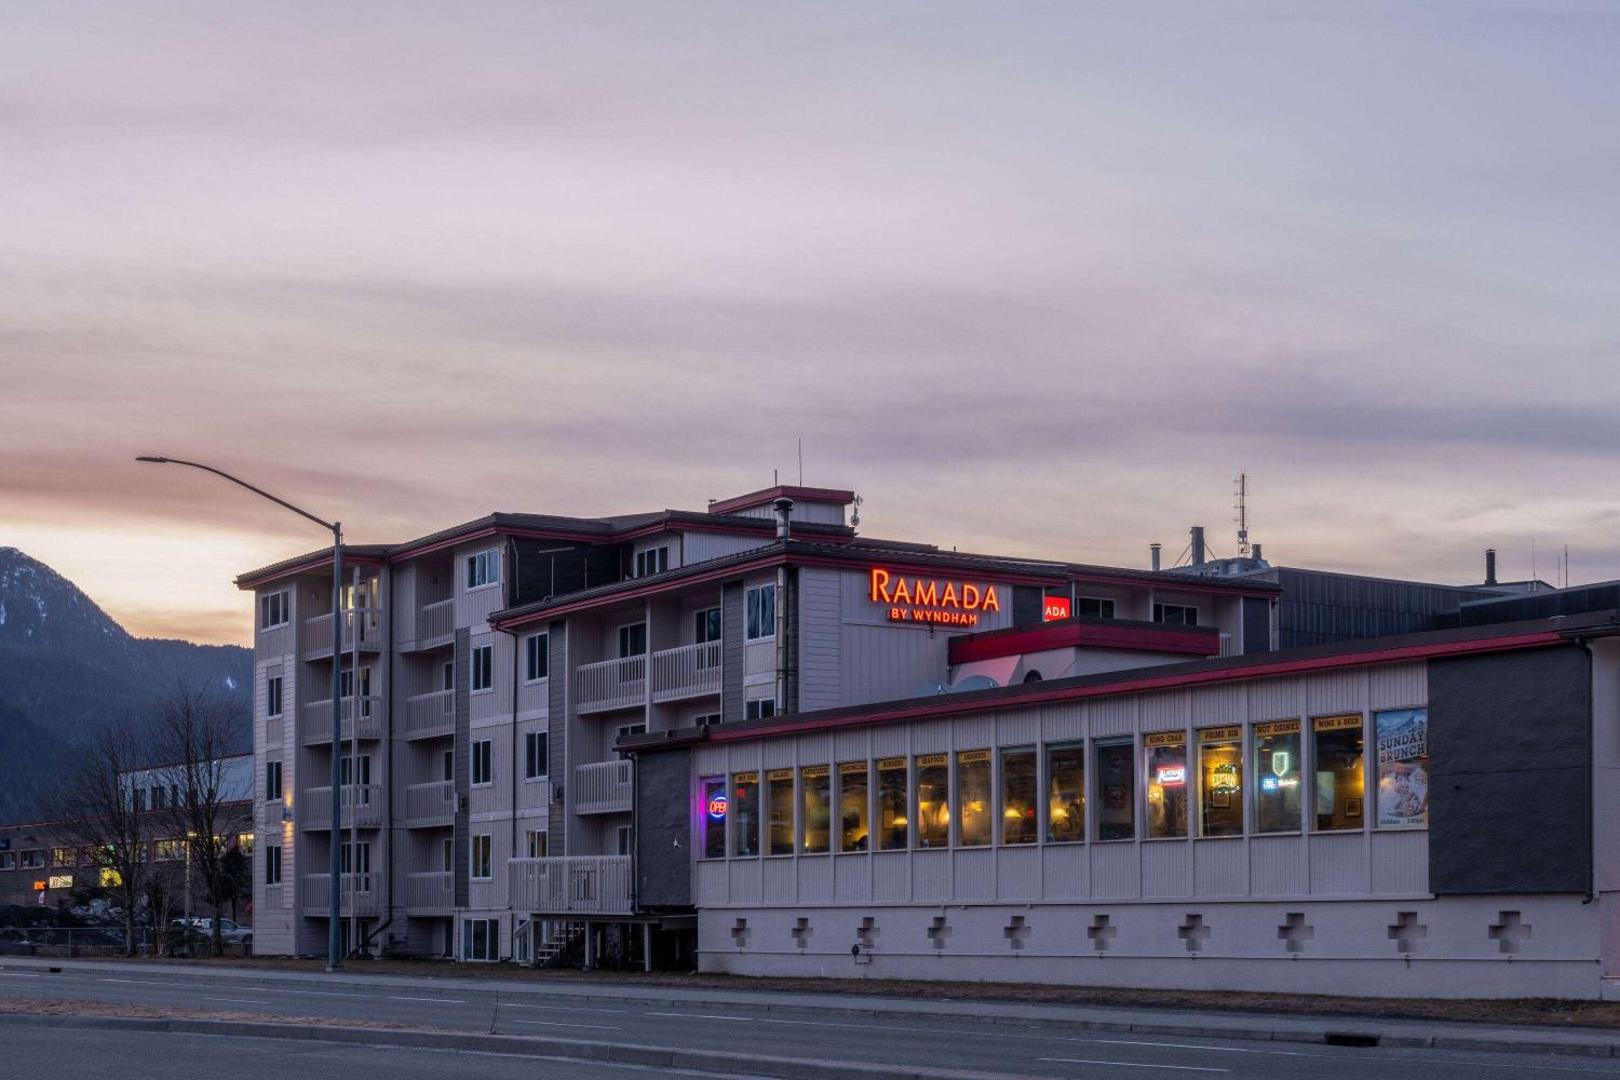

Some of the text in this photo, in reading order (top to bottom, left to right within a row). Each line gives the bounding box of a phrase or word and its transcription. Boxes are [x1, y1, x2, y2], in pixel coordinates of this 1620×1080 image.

[870, 568, 1000, 612] RAMADA
[890, 607, 978, 624] BY WYNDHAM
[1045, 606, 1066, 618] ADA
[1318, 719, 1335, 728] WINE
[1380, 729, 1425, 751] SUNDAY
[1380, 743, 1425, 764] BRUNCH
